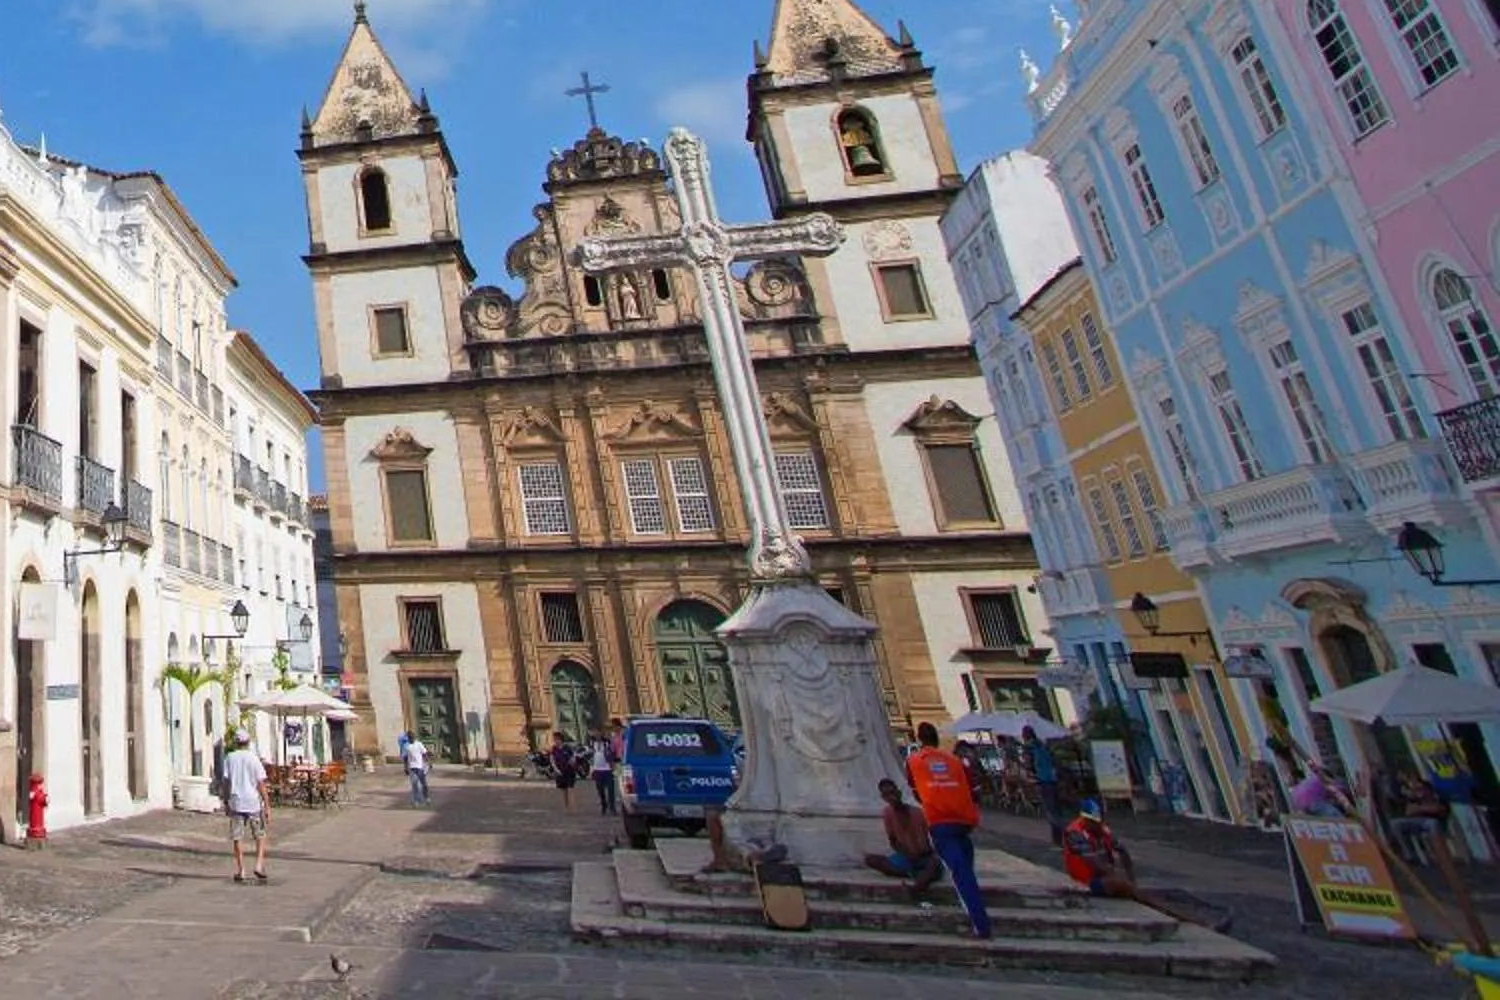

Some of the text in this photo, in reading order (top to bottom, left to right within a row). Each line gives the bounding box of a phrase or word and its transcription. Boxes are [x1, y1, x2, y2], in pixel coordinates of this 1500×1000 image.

[646, 733, 703, 747] E-0032
[1291, 819, 1365, 842] RENT
[1323, 864, 1375, 886] CAR
